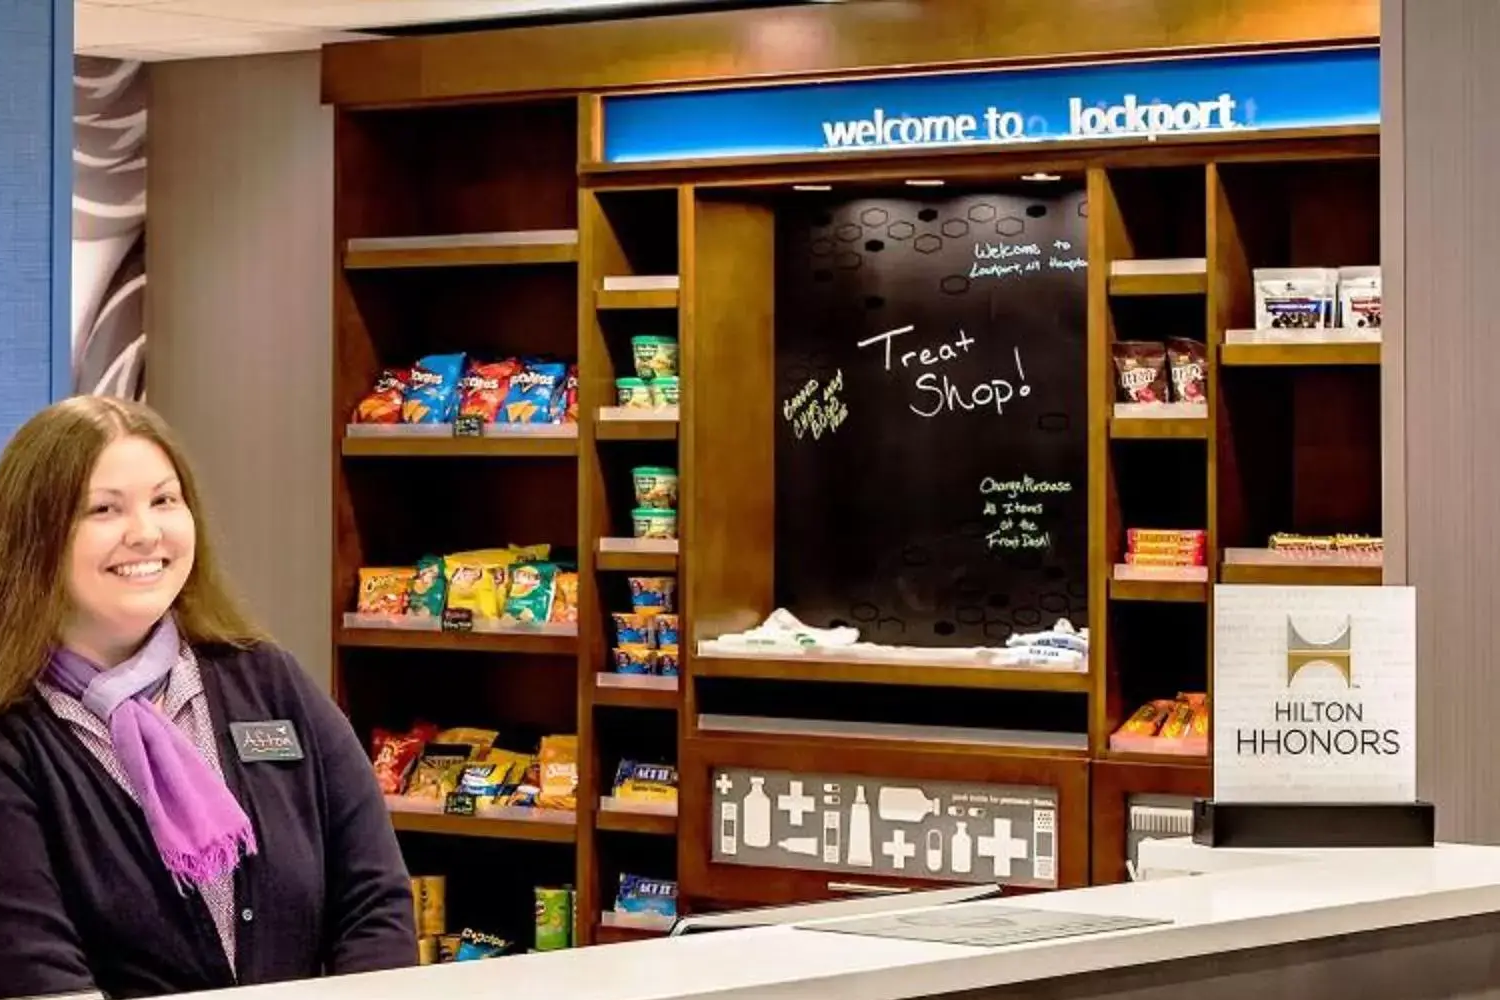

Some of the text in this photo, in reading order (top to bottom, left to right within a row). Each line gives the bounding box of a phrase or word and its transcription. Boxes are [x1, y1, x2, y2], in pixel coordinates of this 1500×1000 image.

[822, 109, 976, 148] welcome
[984, 106, 1025, 139] to
[974, 239, 1071, 259] Welcome to
[857, 324, 976, 371] Treat
[909, 346, 1032, 417] Shop!
[1275, 701, 1363, 723] HILTON
[1236, 728, 1401, 755] HHONORS
